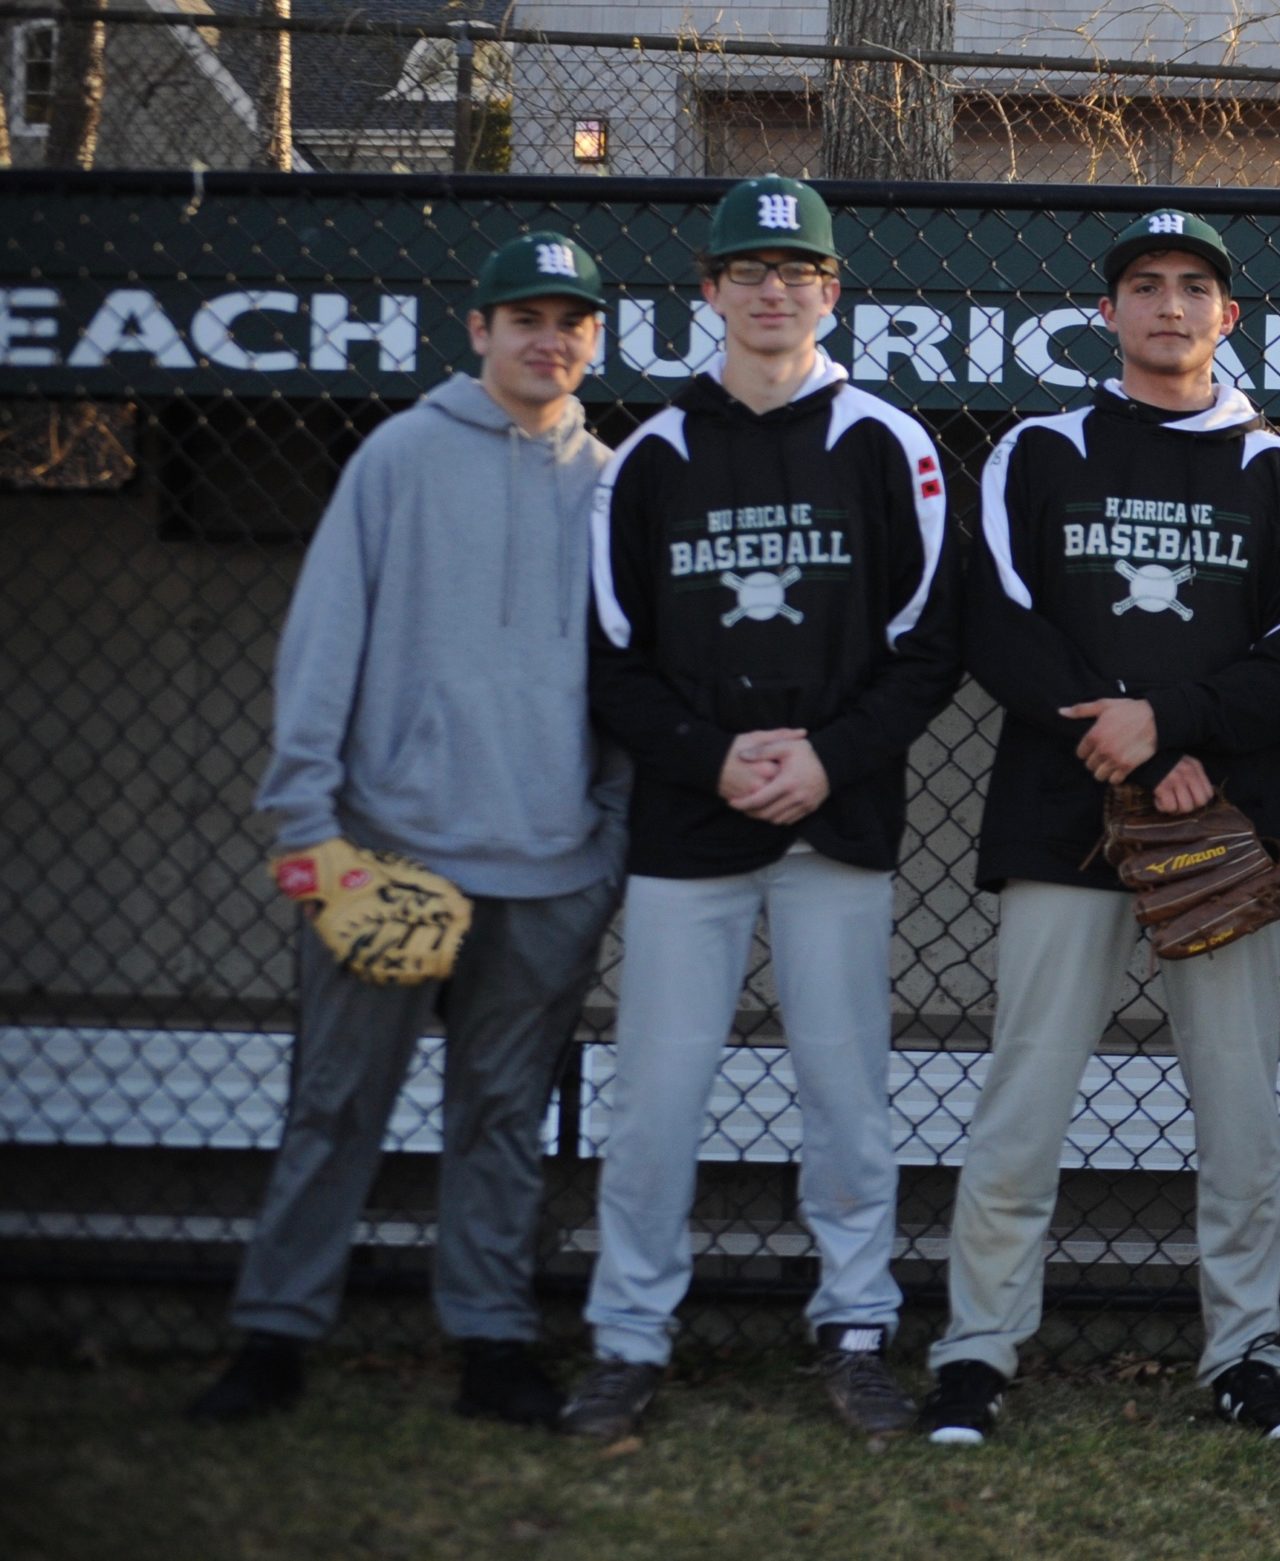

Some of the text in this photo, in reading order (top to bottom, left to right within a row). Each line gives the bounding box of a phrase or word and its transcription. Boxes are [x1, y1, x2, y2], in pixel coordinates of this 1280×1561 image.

[0, 288, 418, 372] EACH
[669, 530, 852, 576] BASEBALL
[1063, 523, 1249, 569] BASEBALL
